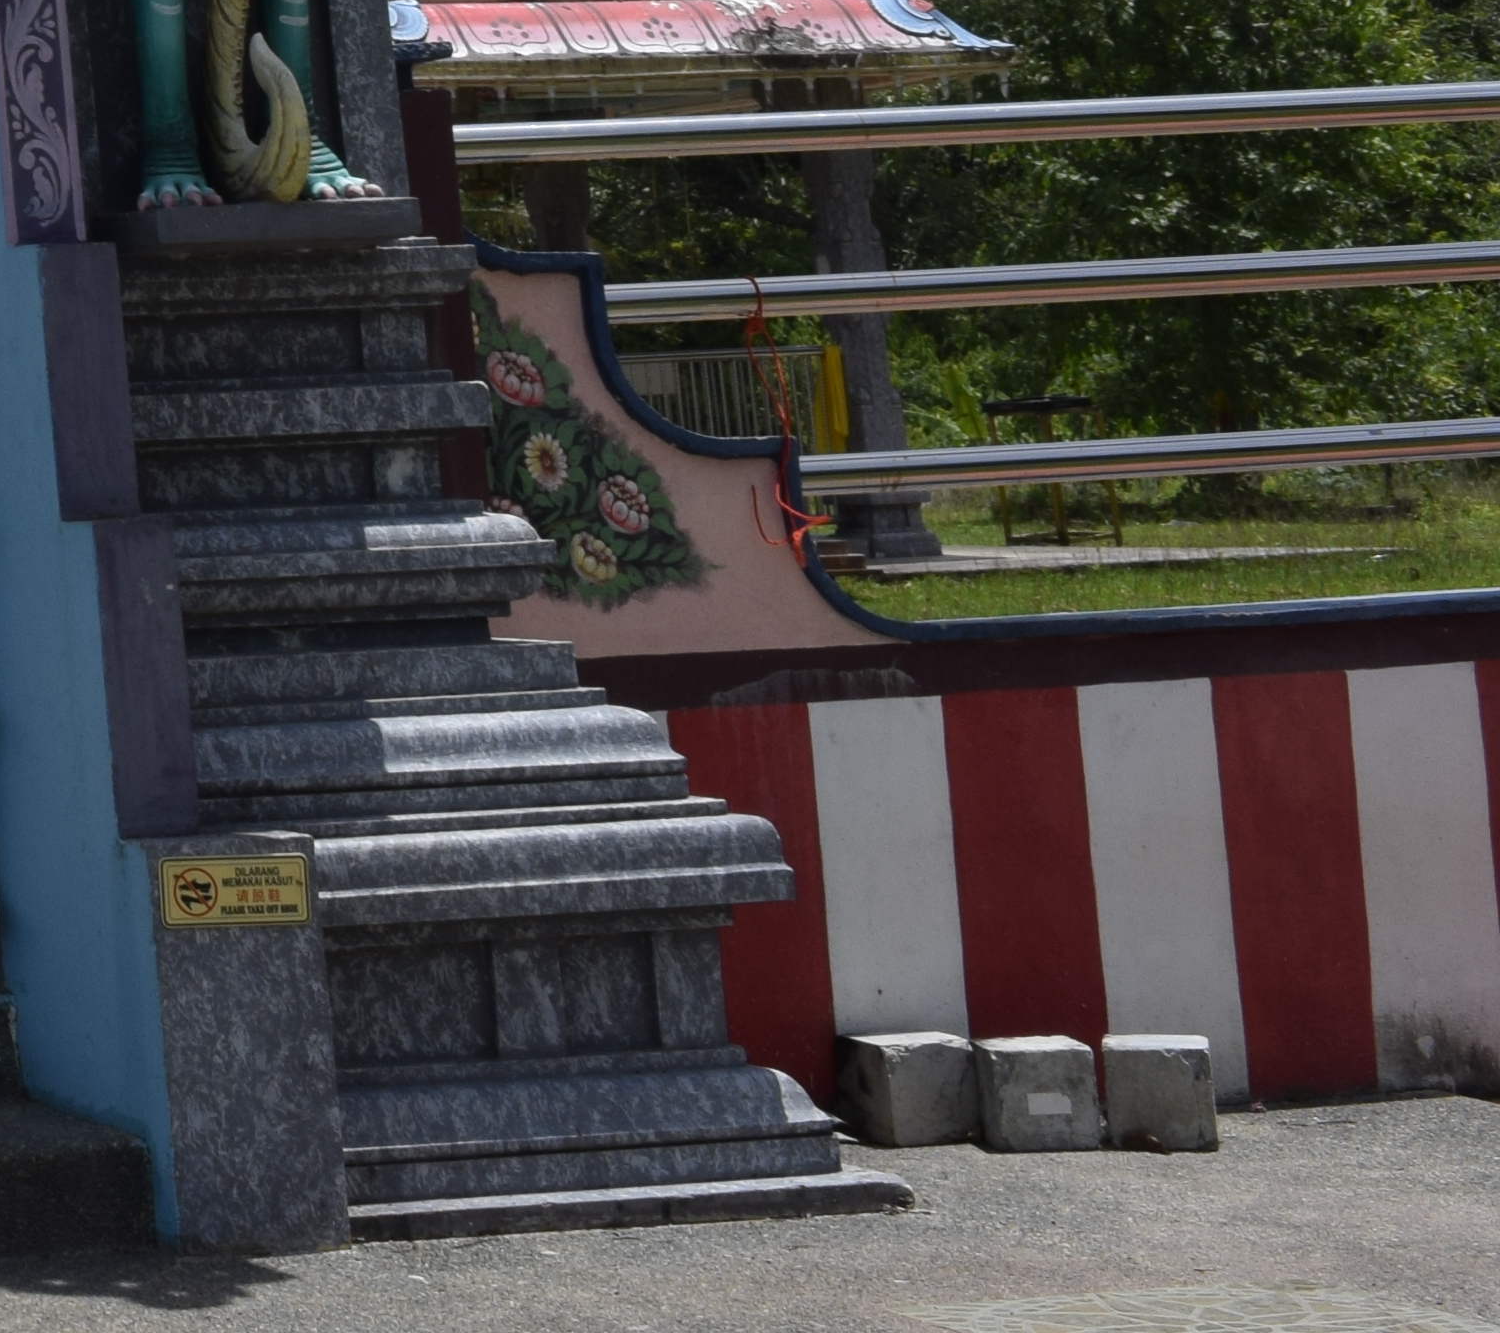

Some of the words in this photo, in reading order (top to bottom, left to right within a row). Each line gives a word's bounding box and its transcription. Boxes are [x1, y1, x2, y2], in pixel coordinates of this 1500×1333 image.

[235, 866, 280, 877] DILARANG
[222, 877, 263, 887] MEMAKAI
[265, 876, 293, 886] KASUT
[221, 906, 246, 915] PLEASE
[247, 905, 265, 914] TAKE
[266, 905, 279, 914] OFF
